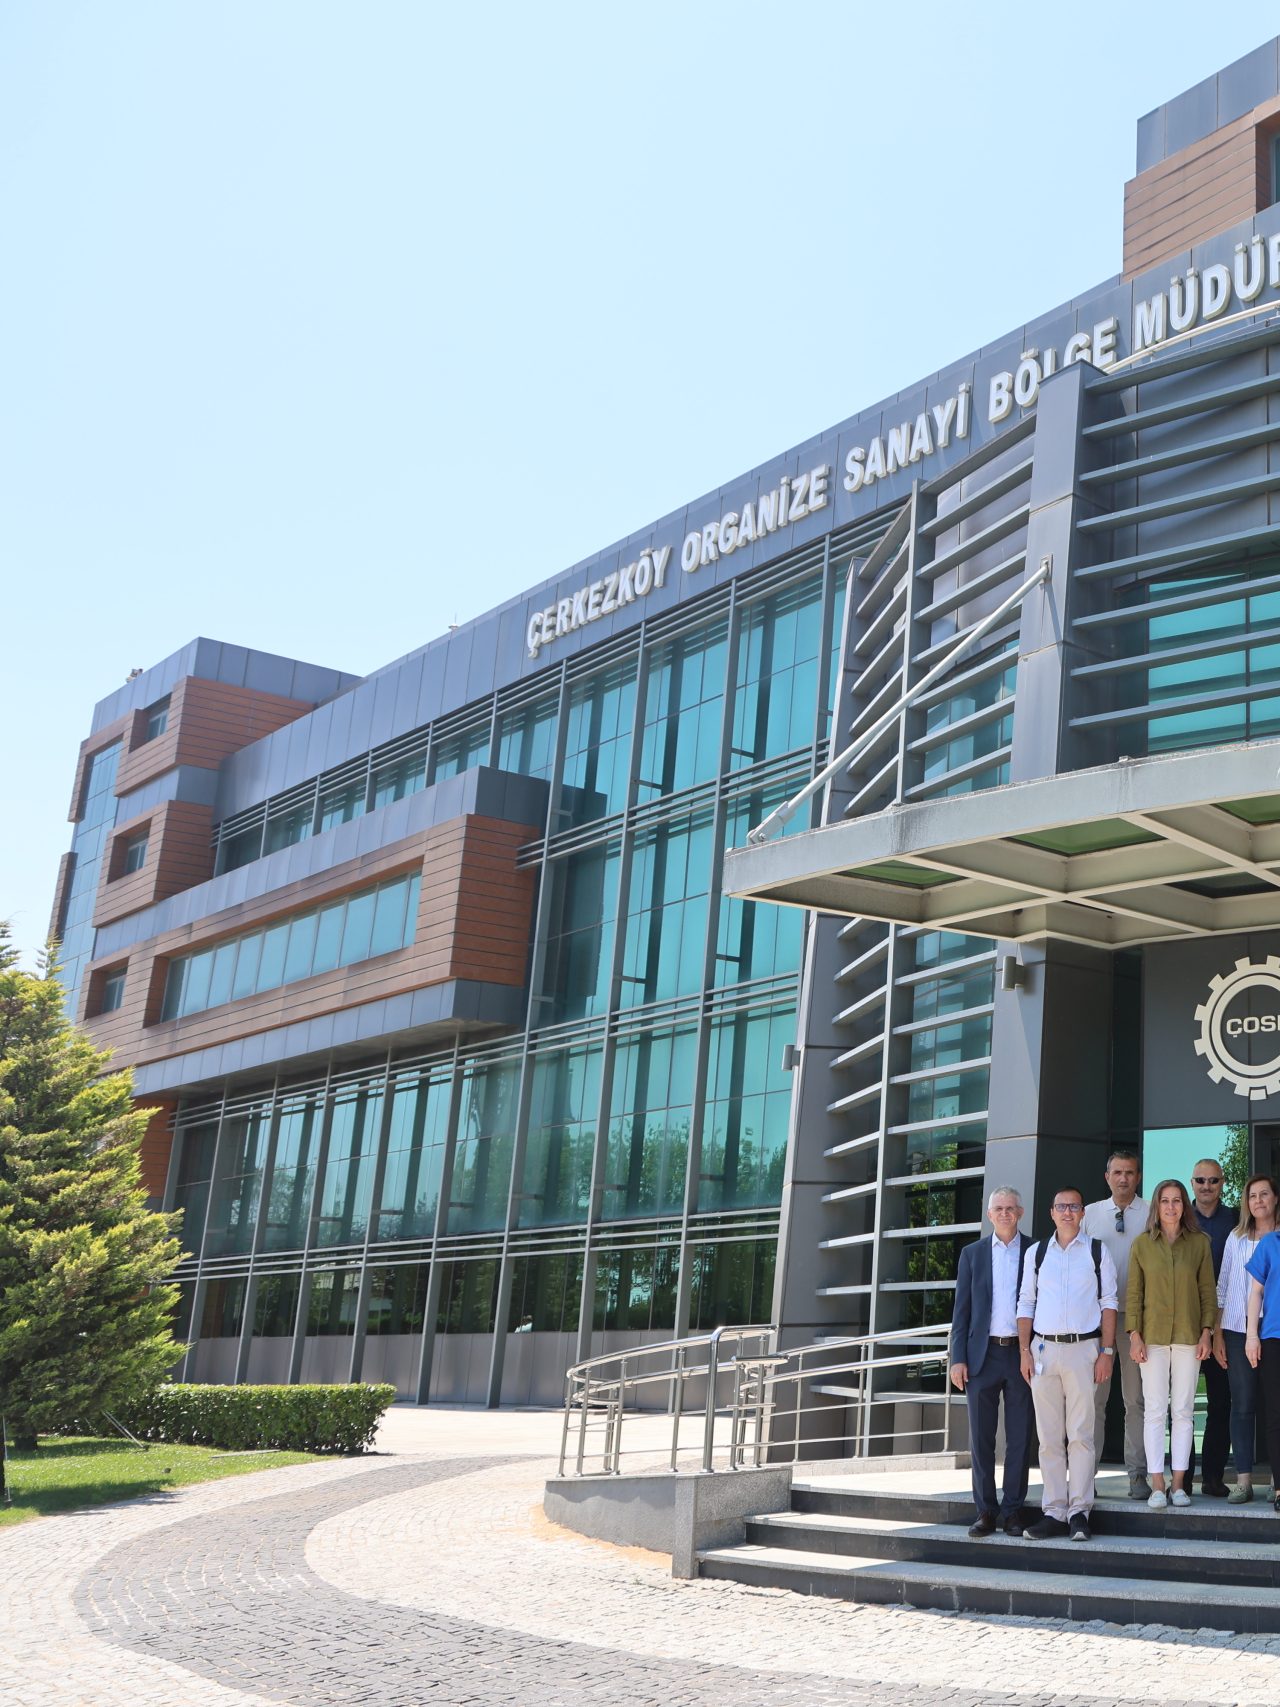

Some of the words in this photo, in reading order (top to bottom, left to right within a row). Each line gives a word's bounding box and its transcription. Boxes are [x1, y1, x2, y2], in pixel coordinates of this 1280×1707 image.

[527, 545, 672, 659] ÇERKEZKÖY
[681, 463, 832, 573] ORGANİZE
[843, 382, 971, 493] SANAYİ
